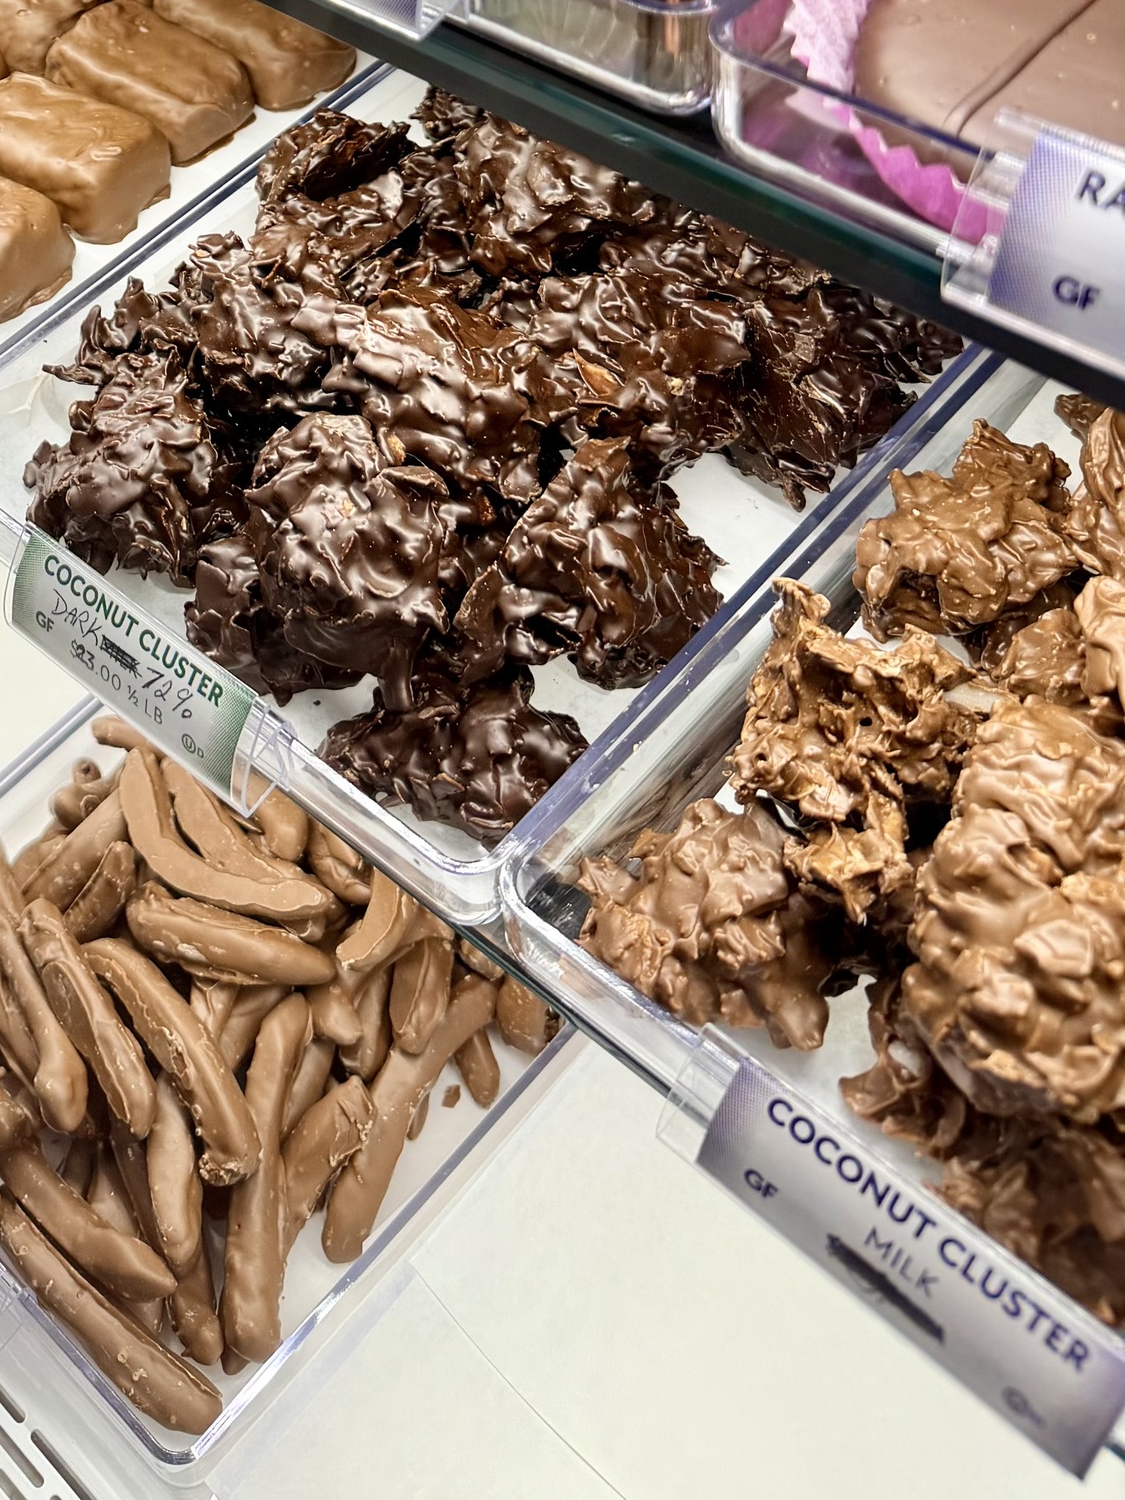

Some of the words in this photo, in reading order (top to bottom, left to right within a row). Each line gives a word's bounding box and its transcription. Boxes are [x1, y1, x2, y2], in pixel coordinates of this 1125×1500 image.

[1052, 274, 1100, 311] GF
[36, 610, 55, 633] GF
[44, 554, 139, 637] COCONUT
[139, 628, 224, 708] CLUSTER
[51, 588, 103, 648] DARK
[144, 698, 163, 726] LB
[743, 1167, 779, 1202] GF
[766, 1097, 936, 1240] COCONUT
[938, 1237, 1092, 1372] CLUSTER
[863, 1226, 942, 1300] MILK
